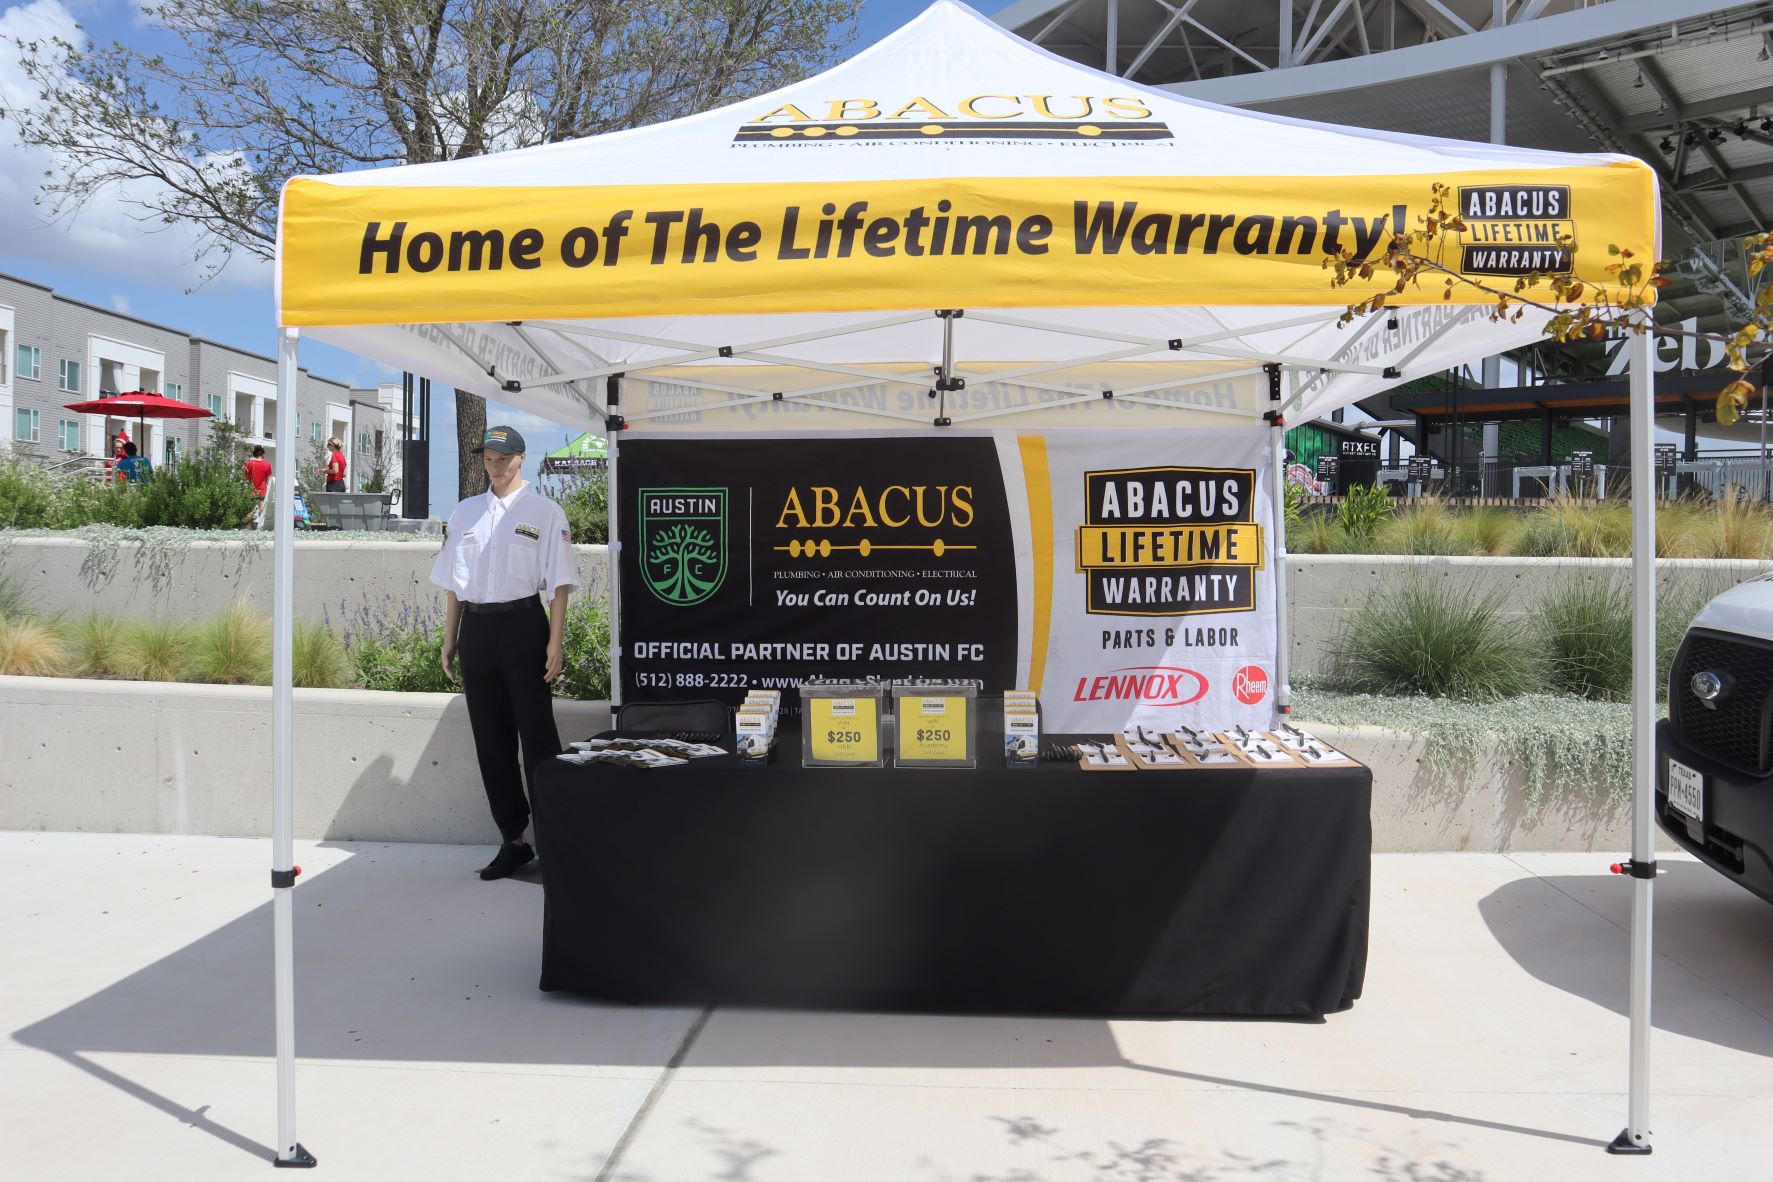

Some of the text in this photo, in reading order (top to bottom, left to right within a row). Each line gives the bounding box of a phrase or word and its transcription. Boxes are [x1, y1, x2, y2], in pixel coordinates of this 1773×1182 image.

[753, 95, 1153, 123] ABACUS
[1469, 190, 1560, 216] ABACUS
[358, 198, 1408, 275] Home of The Lifetime Warranty!
[1471, 223, 1560, 242] LIFETIME
[1472, 250, 1562, 269] WARRANTY
[1342, 441, 1377, 453] ATXFC
[650, 499, 716, 514] AUSTIN
[775, 485, 974, 528] ABACUS
[1101, 479, 1239, 518] ABACUS
[1101, 529, 1239, 563] LIFETIME
[663, 564, 703, 575] F C
[773, 570, 977, 579] PLUMBING AIR CONDITIONING ELECTRICAL
[775, 589, 977, 607] You Can Count On Us!
[1102, 574, 1238, 604] WARRANTY
[1102, 627, 1239, 649] PARTS & LABOR
[634, 642, 984, 661] OFFICIAL PARTNER OF AUSTIN FC
[635, 672, 672, 689] (512)
[676, 673, 748, 688] 888-2222
[1073, 674, 1184, 702] LENNOX
[1236, 667, 1267, 700] Rheem
[827, 730, 862, 743] $250
[916, 728, 951, 742] $250
[1678, 766, 1692, 780] TEXAS
